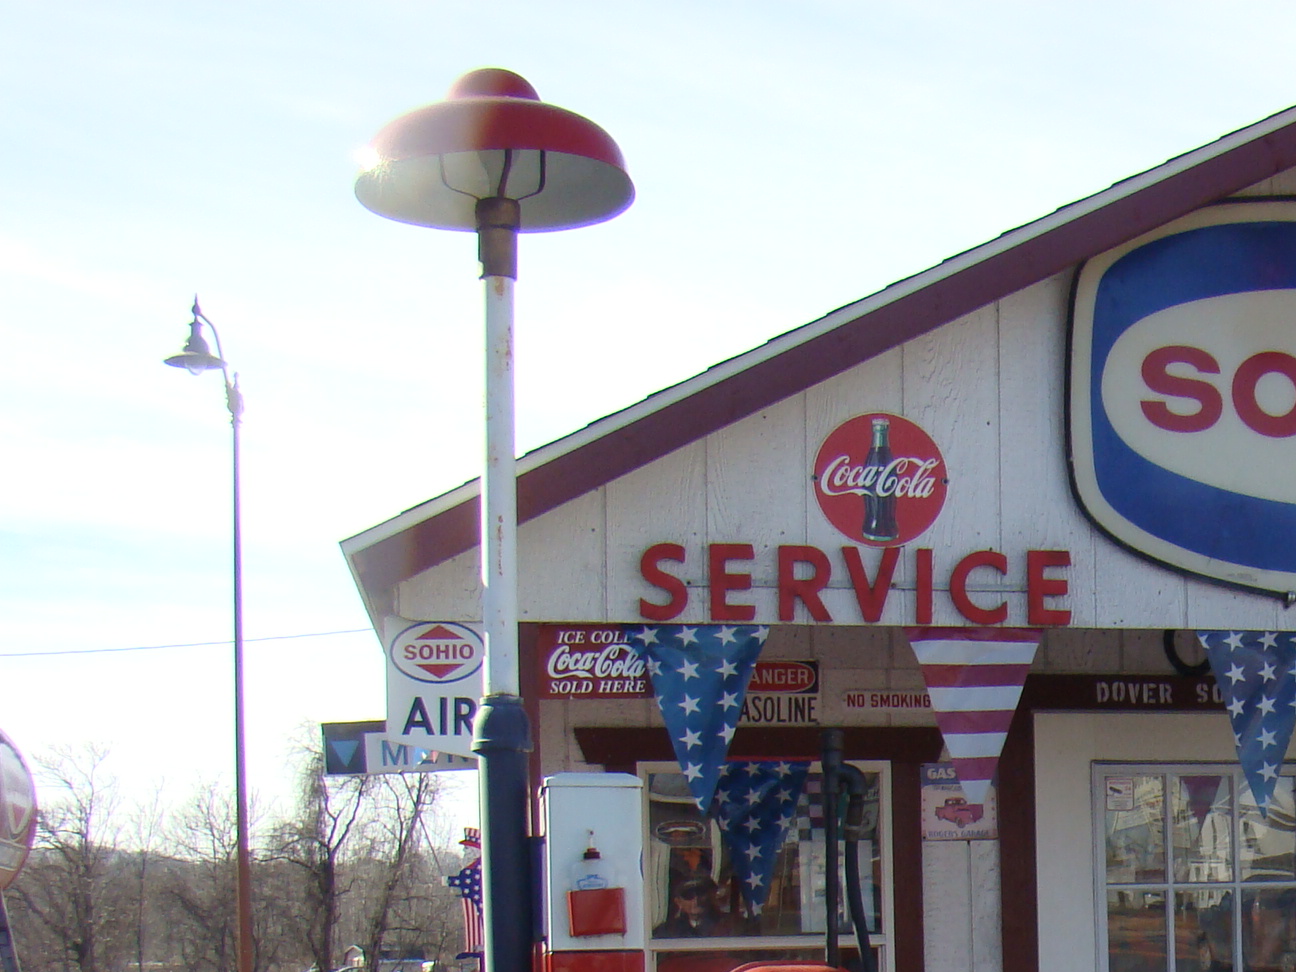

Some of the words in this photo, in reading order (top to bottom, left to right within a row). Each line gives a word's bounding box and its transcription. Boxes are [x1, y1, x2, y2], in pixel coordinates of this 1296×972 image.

[821, 455, 940, 499] Coca-Cola
[639, 543, 1072, 625] SERVICE
[557, 631, 586, 644] ICE
[404, 644, 474, 660] SOHIO
[547, 644, 647, 679] Coca-Cola
[550, 681, 593, 694] SOLD
[599, 680, 646, 694] HERE
[1096, 681, 1173, 704] DOVER
[739, 696, 817, 723] ASOLINE
[847, 694, 865, 707] NO
[871, 694, 931, 708] SMOKING
[402, 697, 478, 735] AIR
[927, 767, 956, 780] GAS
